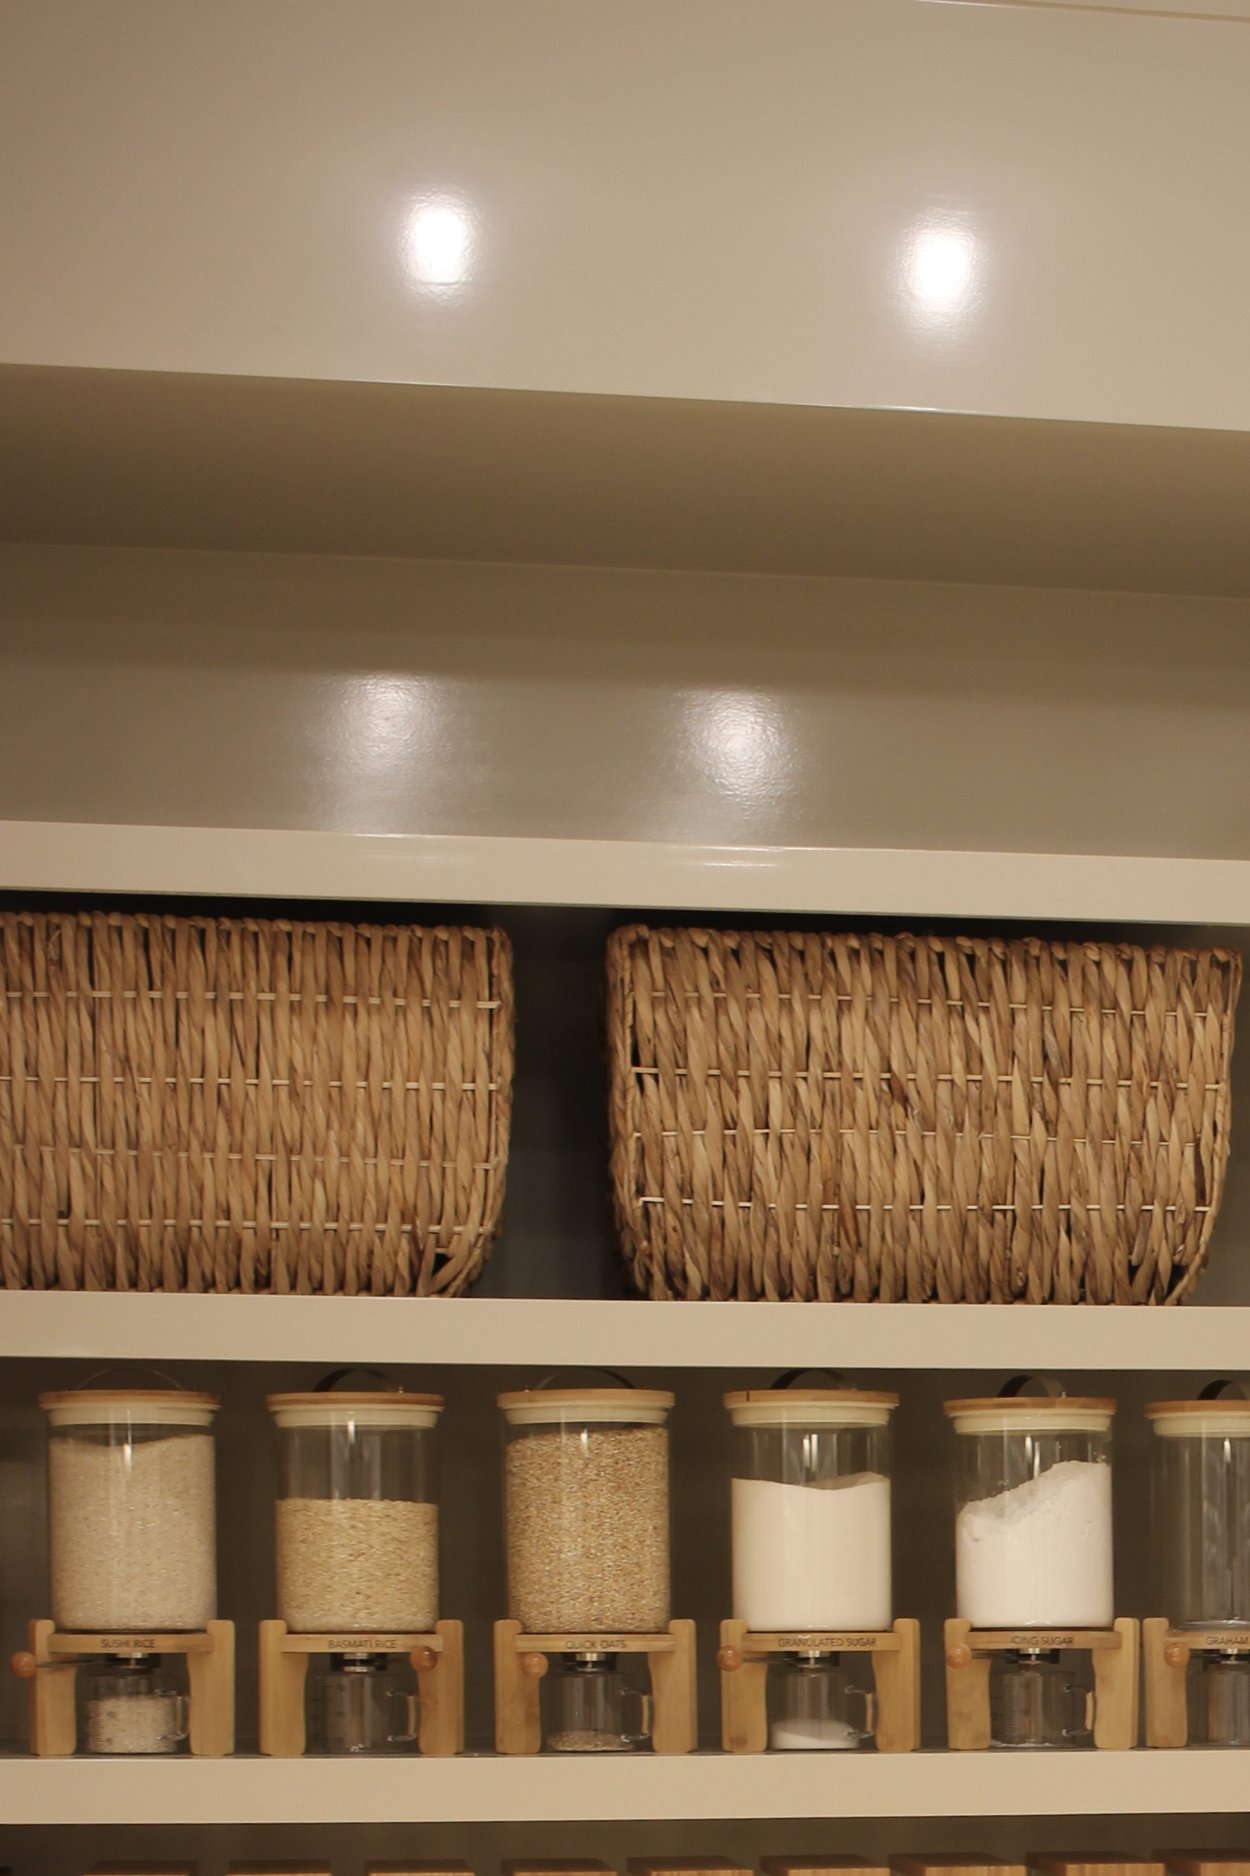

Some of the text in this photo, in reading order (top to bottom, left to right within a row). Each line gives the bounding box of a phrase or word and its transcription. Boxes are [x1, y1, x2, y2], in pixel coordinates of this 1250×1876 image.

[101, 1638, 156, 1649] SUSHI RICE
[328, 1639, 397, 1650] BASMATI RICE
[565, 1639, 627, 1650] QUICK OATS
[778, 1636, 877, 1648] GRANULATED SUGAR
[1010, 1635, 1074, 1645] ICING SUGAR
[1206, 1636, 1250, 1645] GRAHAM
